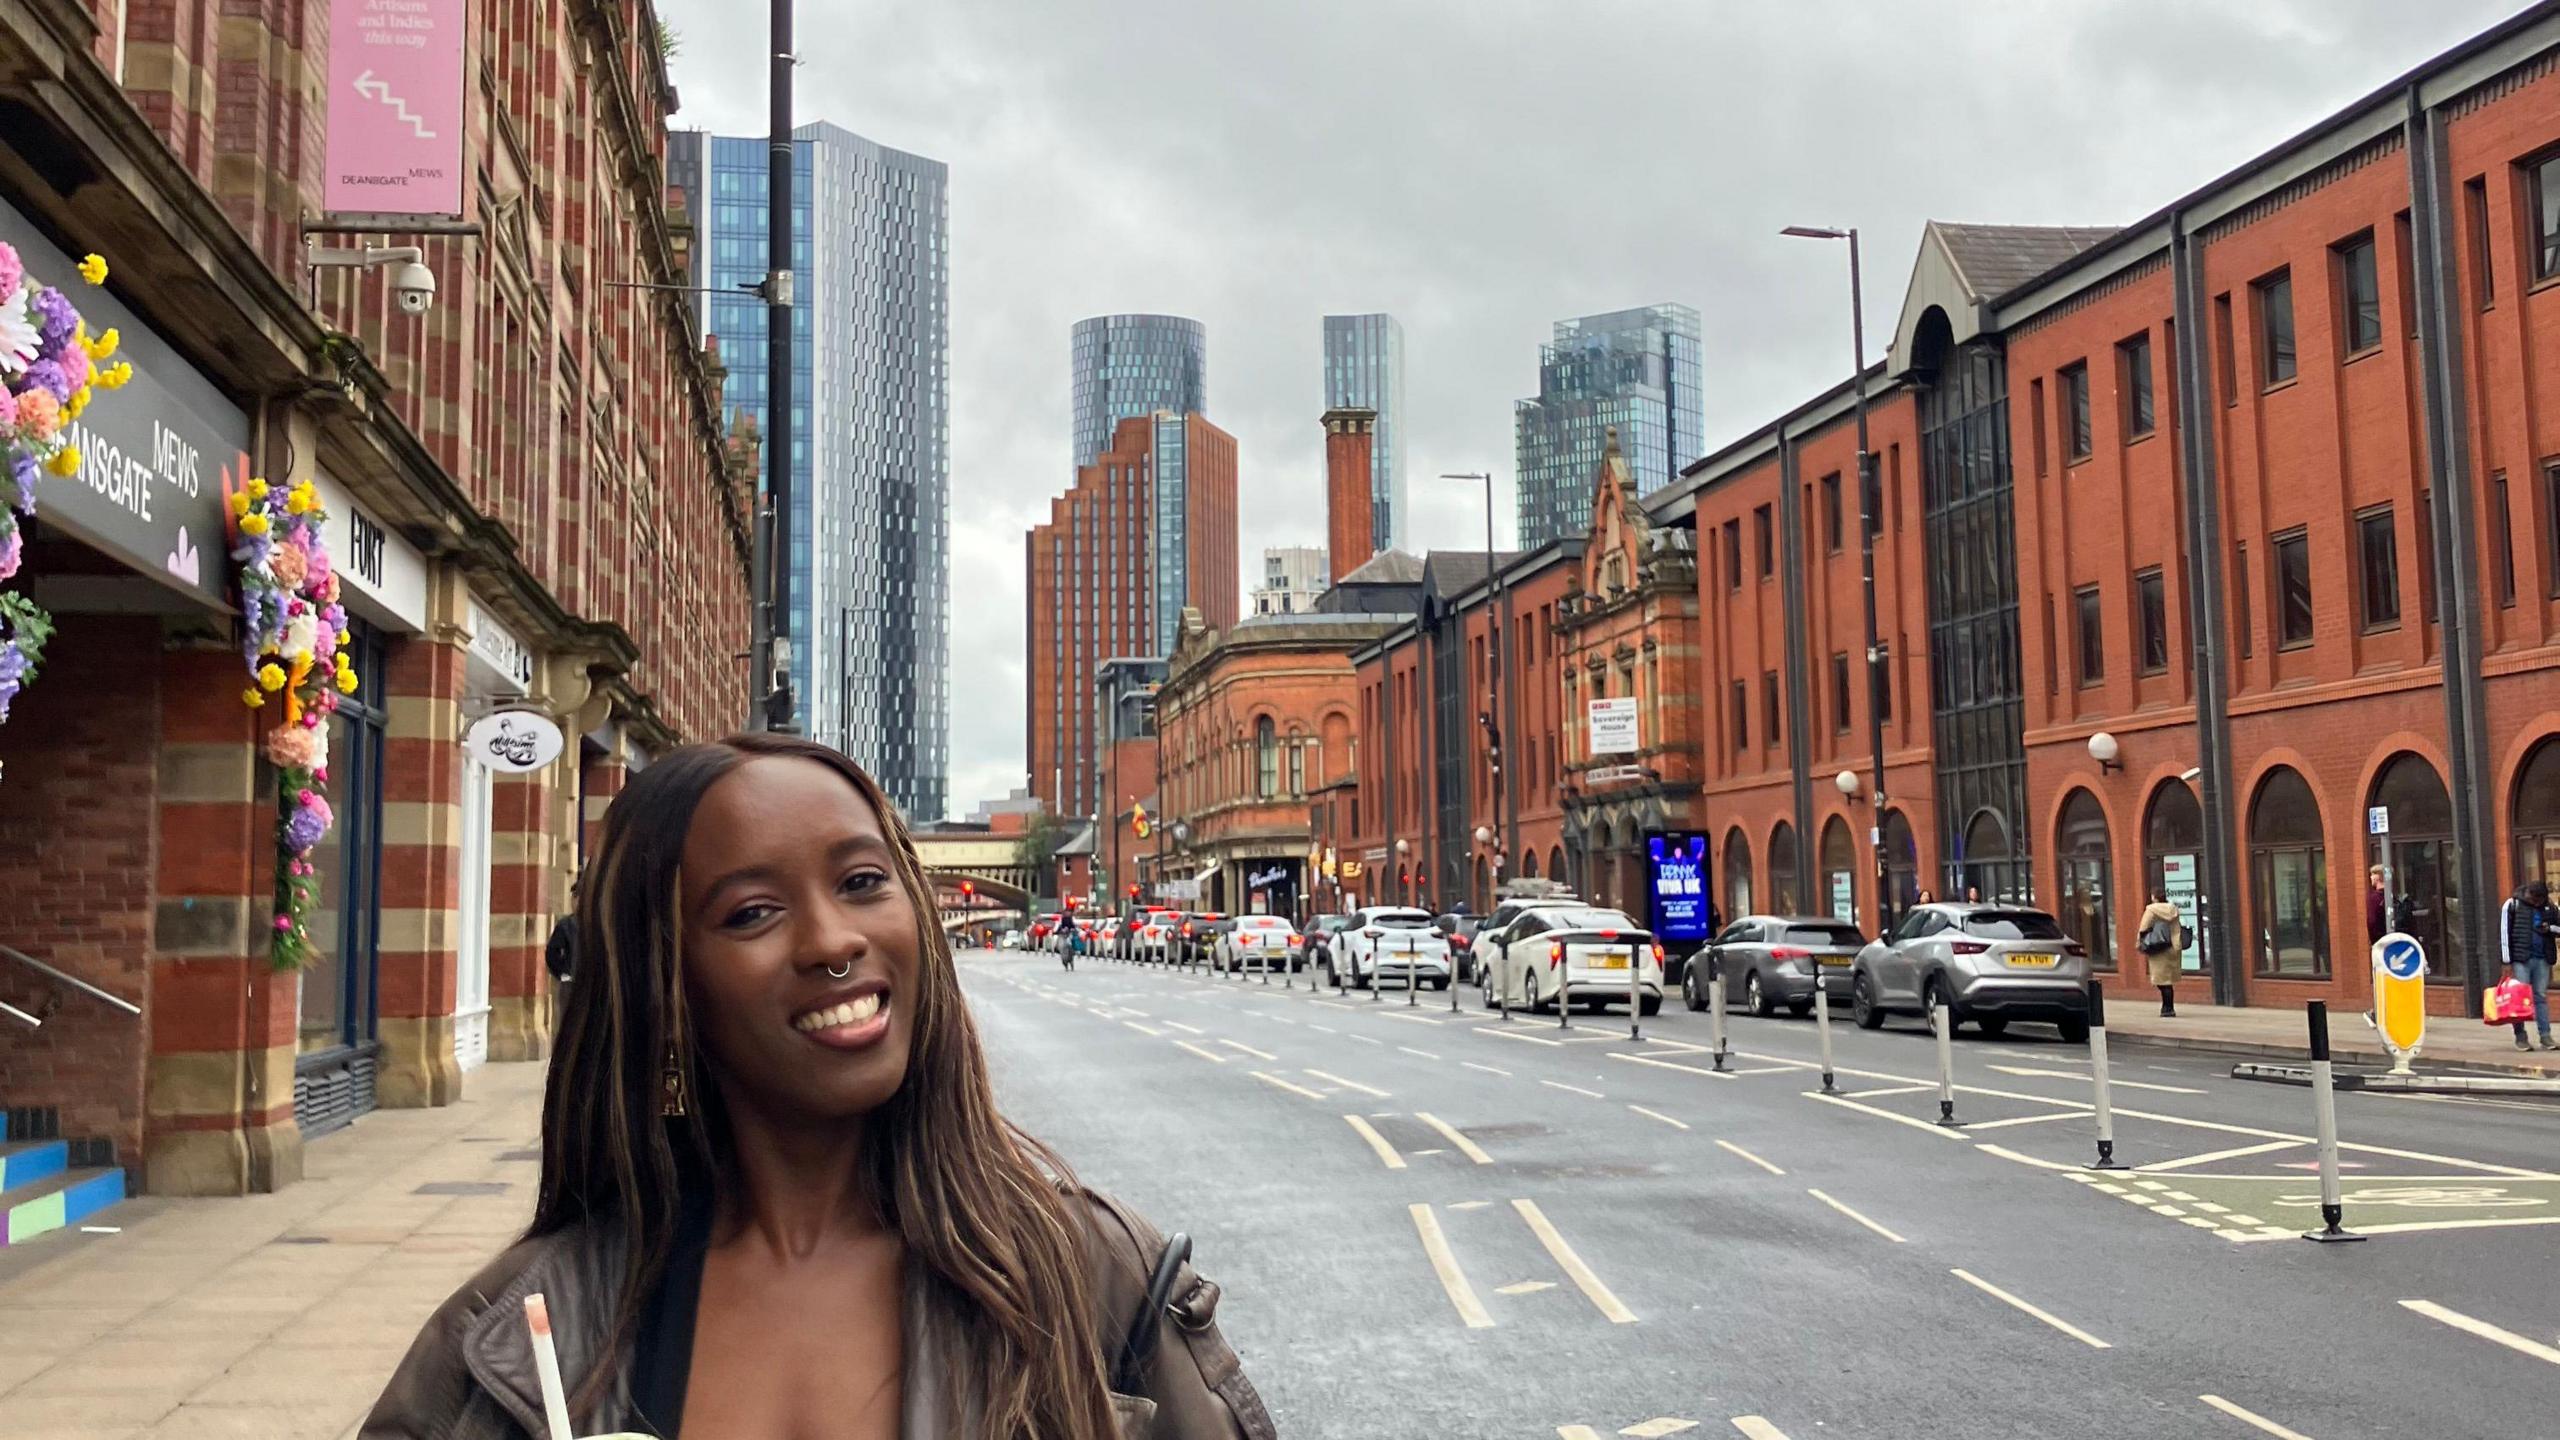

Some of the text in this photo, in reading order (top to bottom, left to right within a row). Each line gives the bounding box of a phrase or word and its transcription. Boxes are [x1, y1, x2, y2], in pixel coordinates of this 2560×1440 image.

[358, 14, 434, 29] and Indies
[364, 31, 426, 48] this way
[341, 168, 443, 186] DEANSGATE MEWS
[153, 419, 199, 498] MEWS
[1592, 712, 1635, 724] Sovereign
[1601, 724, 1626, 732] House
[1683, 878, 1701, 894] UK
